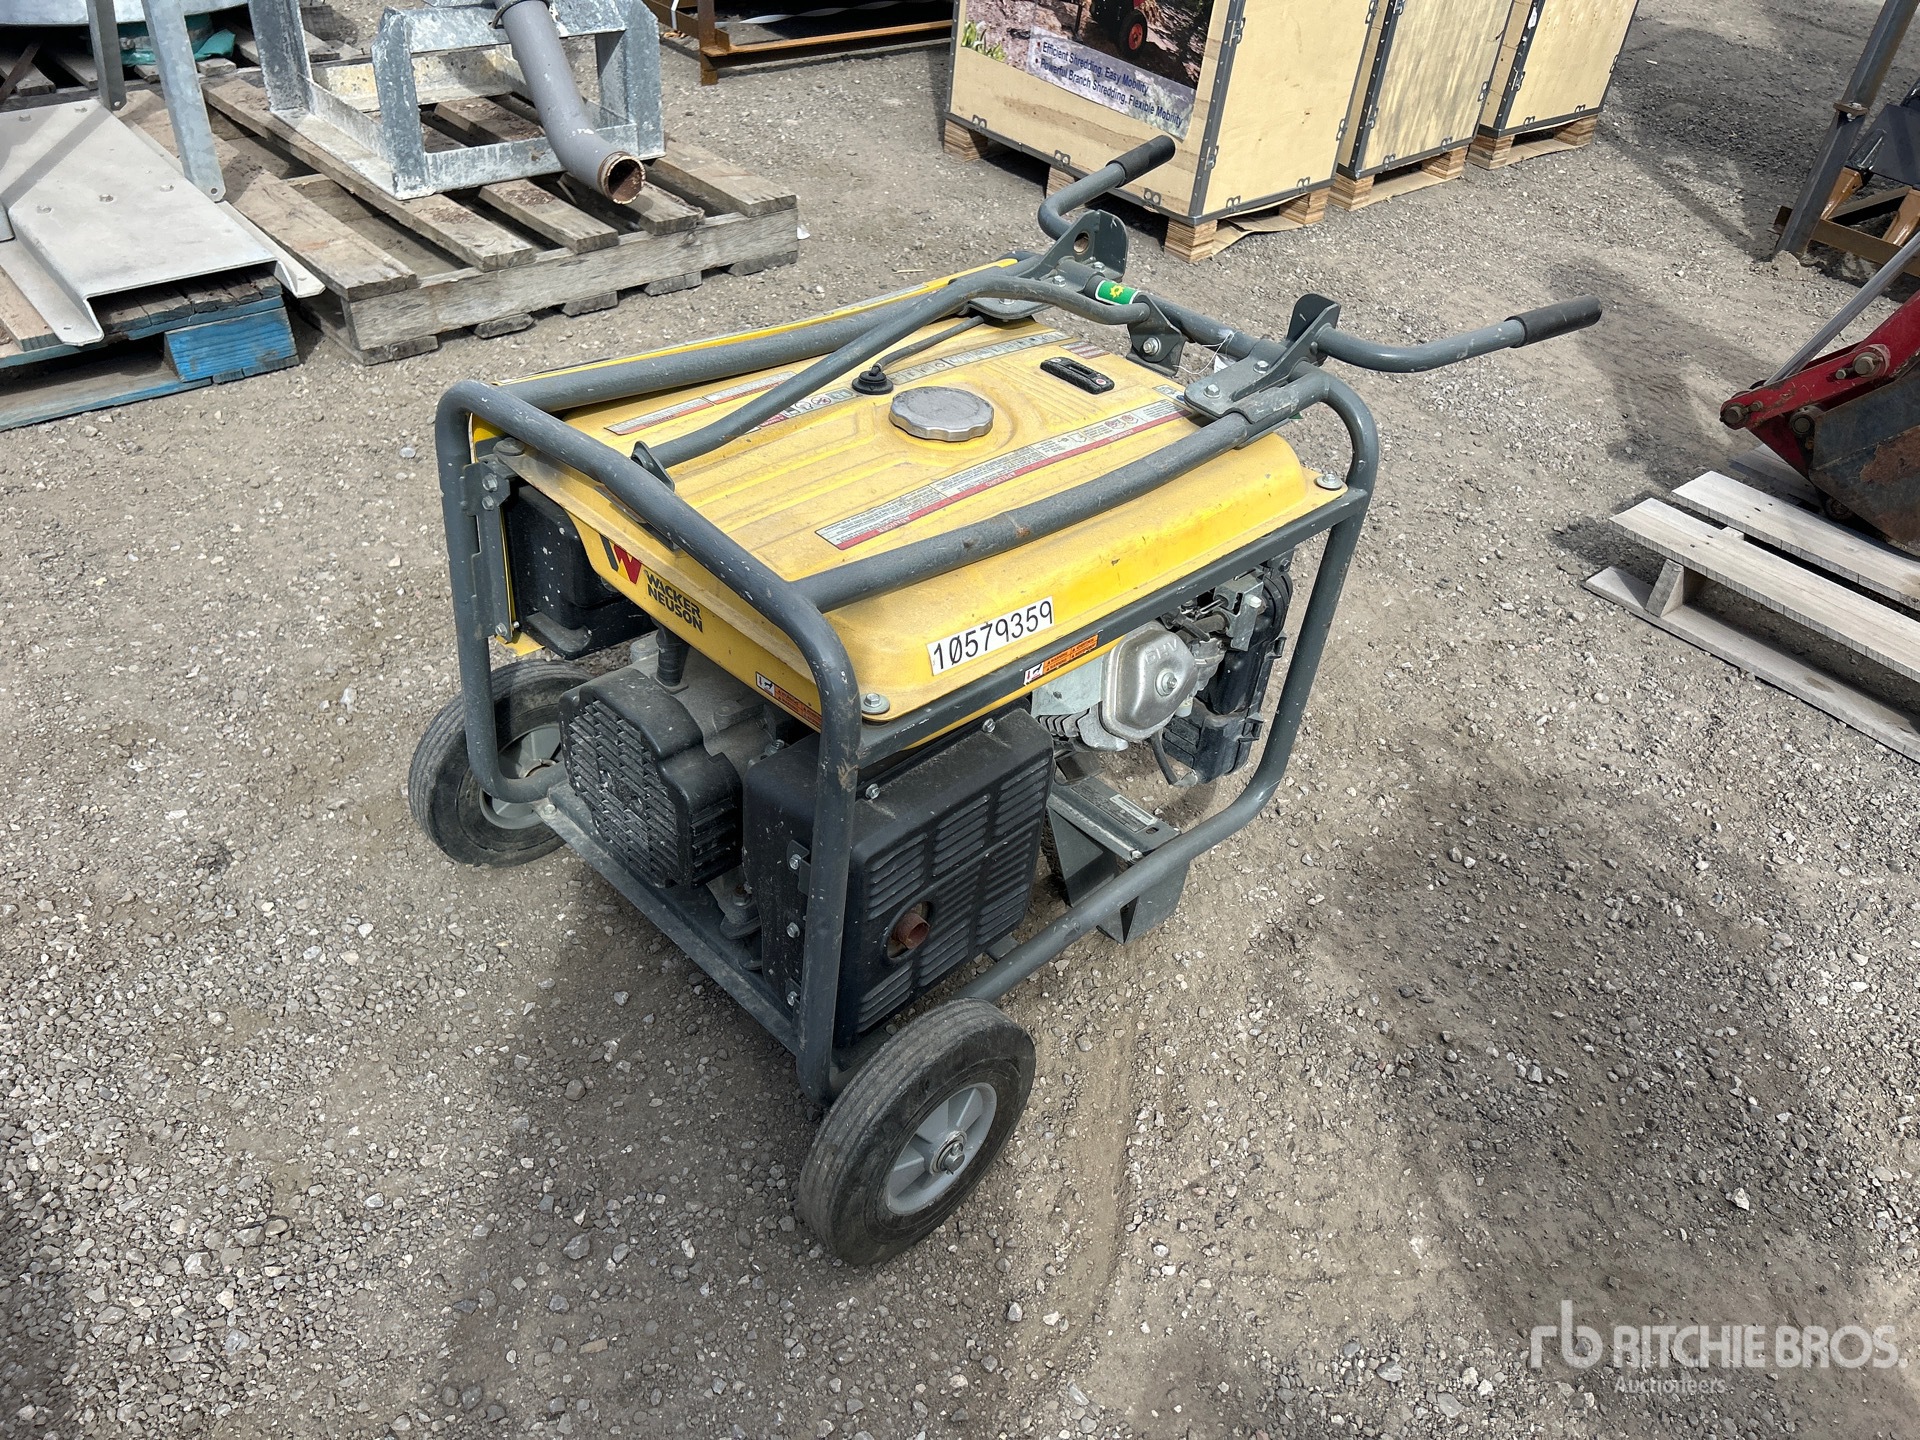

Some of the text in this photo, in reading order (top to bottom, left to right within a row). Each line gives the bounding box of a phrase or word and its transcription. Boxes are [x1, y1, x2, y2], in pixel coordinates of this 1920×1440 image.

[1041, 57, 1068, 77] Powerful
[1068, 70, 1091, 88] Branch
[1128, 94, 1155, 115] Flexible
[1156, 105, 1183, 129] Mobility
[1042, 41, 1069, 62] Efficient
[1104, 66, 1121, 84] Easy
[1122, 73, 1149, 96] Mobility
[643, 569, 702, 620] WACKER
[647, 583, 703, 634] NEUSON
[933, 600, 1053, 670] 10579359
